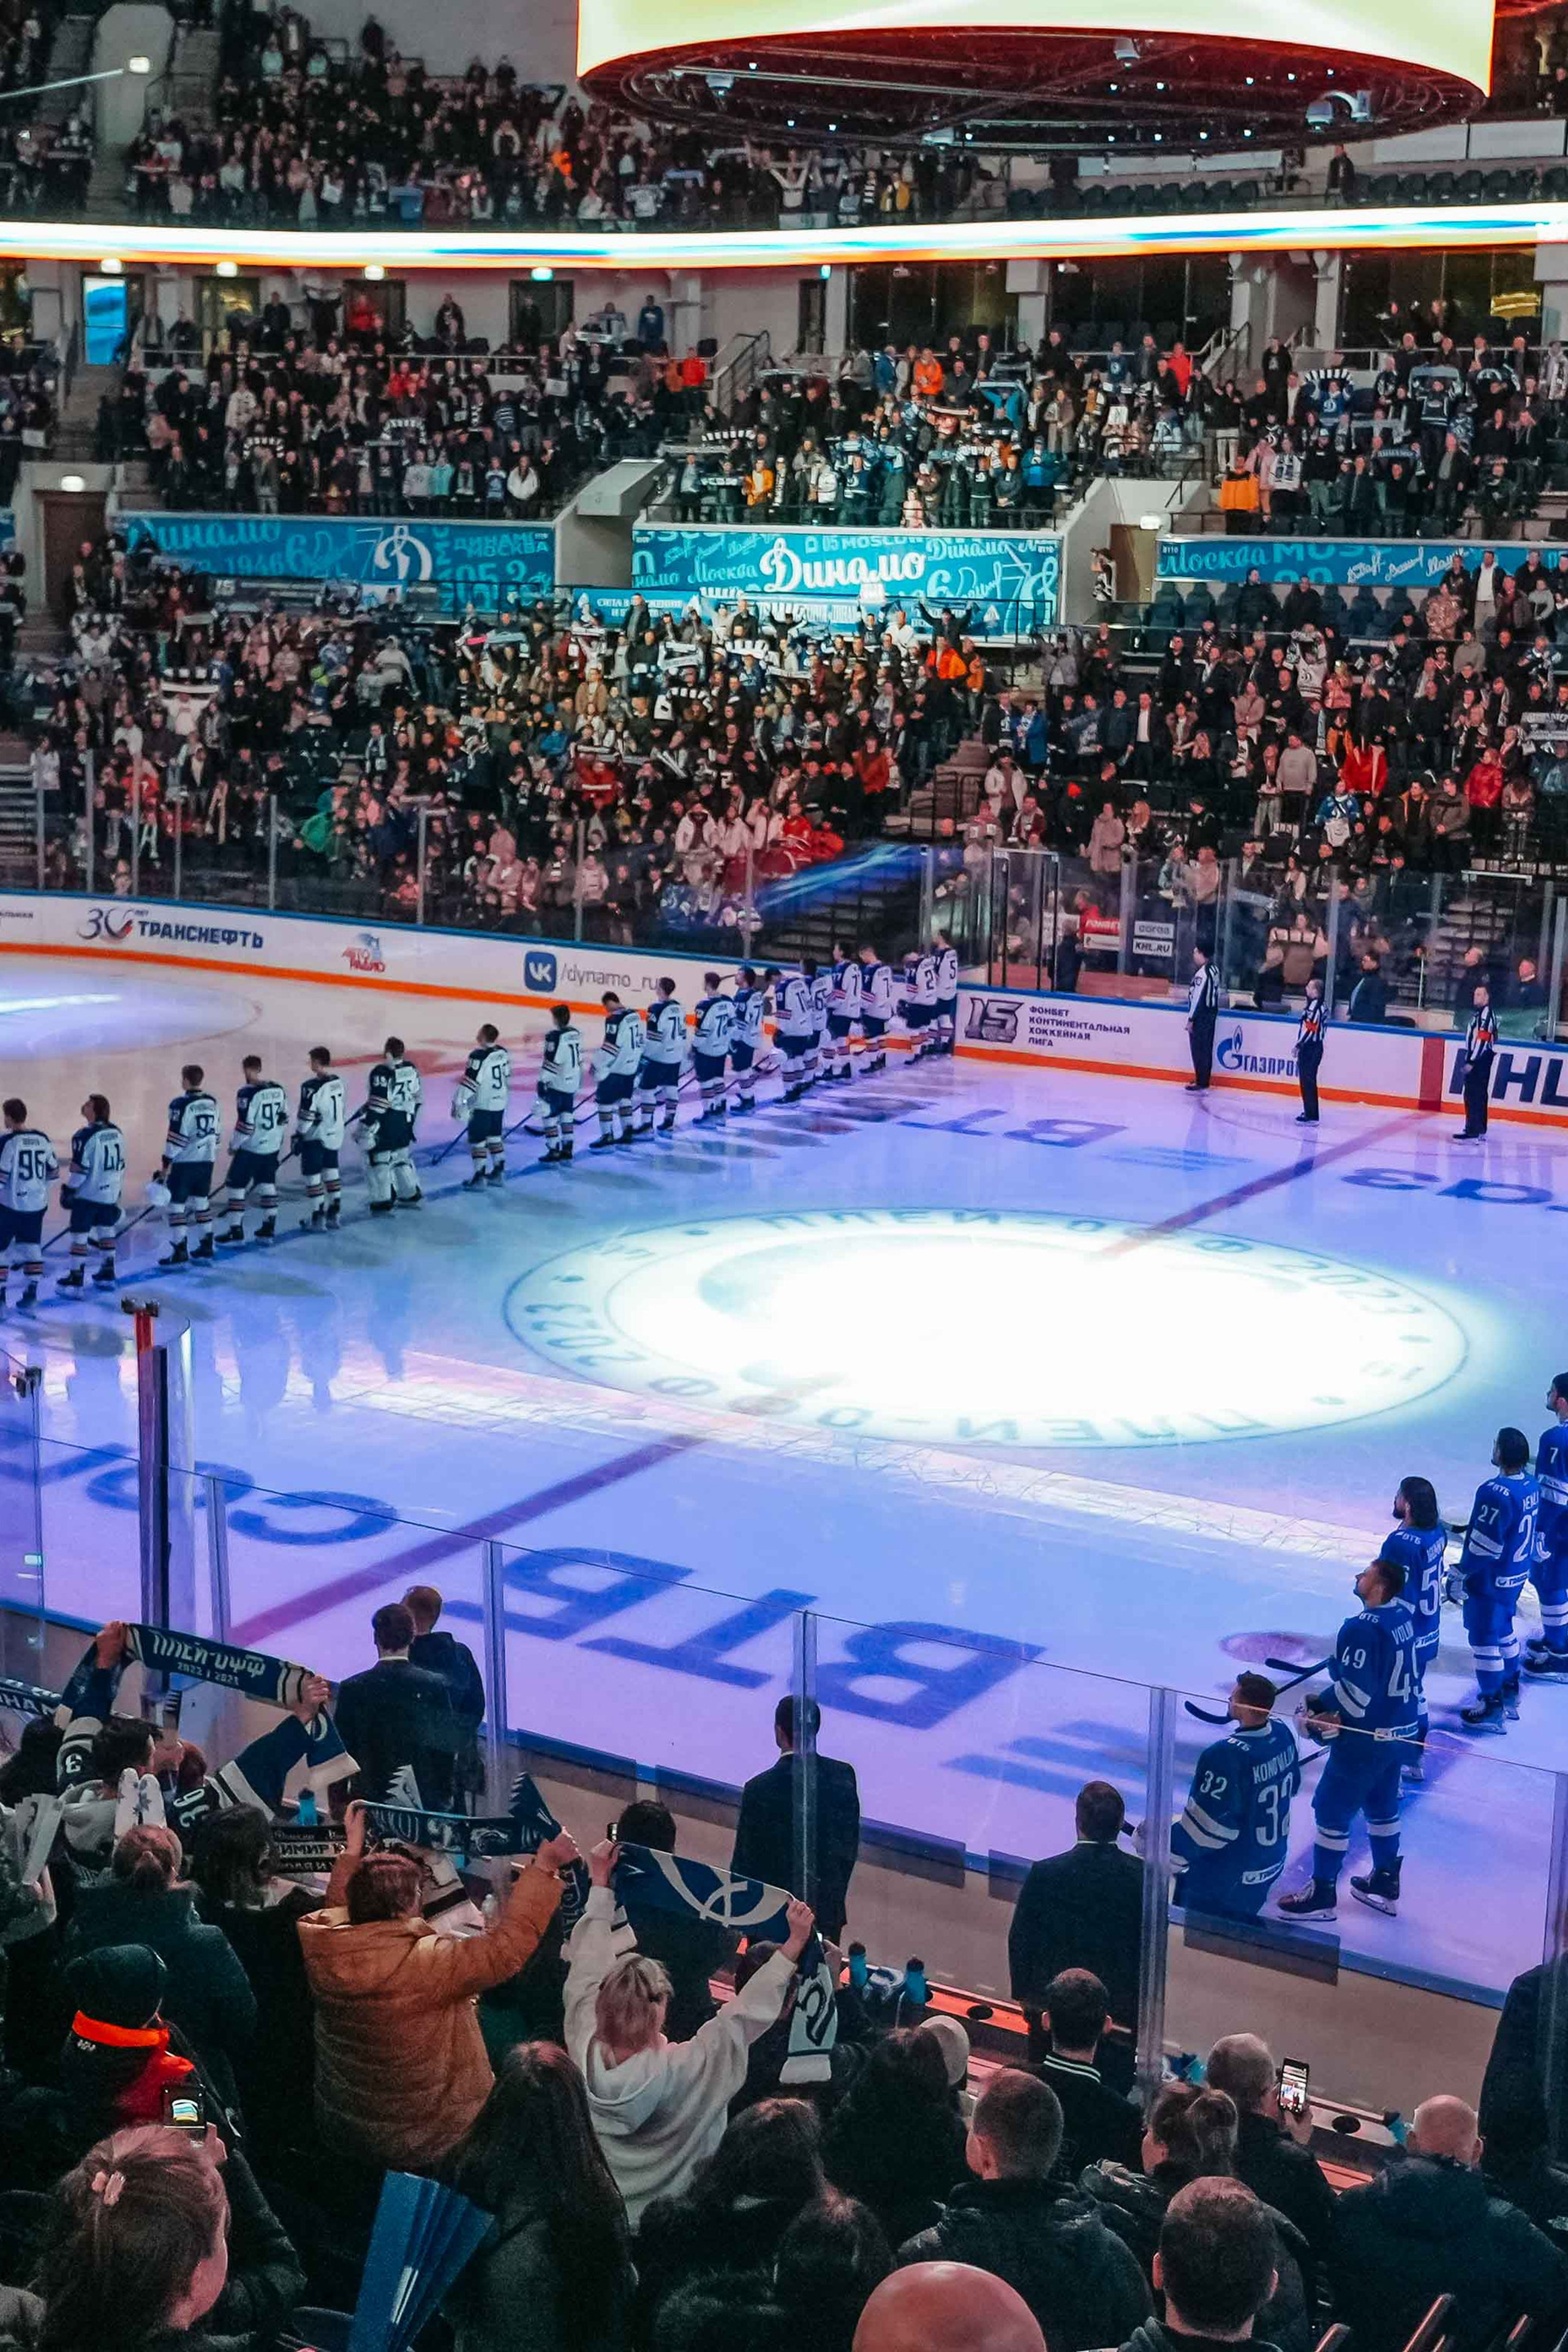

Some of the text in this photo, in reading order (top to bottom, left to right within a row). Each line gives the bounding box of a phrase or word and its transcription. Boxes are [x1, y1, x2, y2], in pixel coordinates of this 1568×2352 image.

[760, 537, 926, 592] Динамо
[138, 920, 264, 949] ТРАНСНЕФТЬ
[1135, 943, 1170, 953] KHL.RU
[1030, 1006, 1070, 1017] ФОНБЕТ
[1029, 1017, 1130, 1035] КОНТИНЕНТАЛЬНАЯ
[1029, 1026, 1091, 1041] ХОККЕЙНАЯ
[1028, 1037, 1054, 1047] ЛИГА
[18, 1150, 45, 1180] 96
[1550, 1447, 1559, 1464] 7
[1477, 1504, 1500, 1525] 27
[1341, 1645, 1366, 1670] 49
[1199, 1770, 1227, 1801] 32
